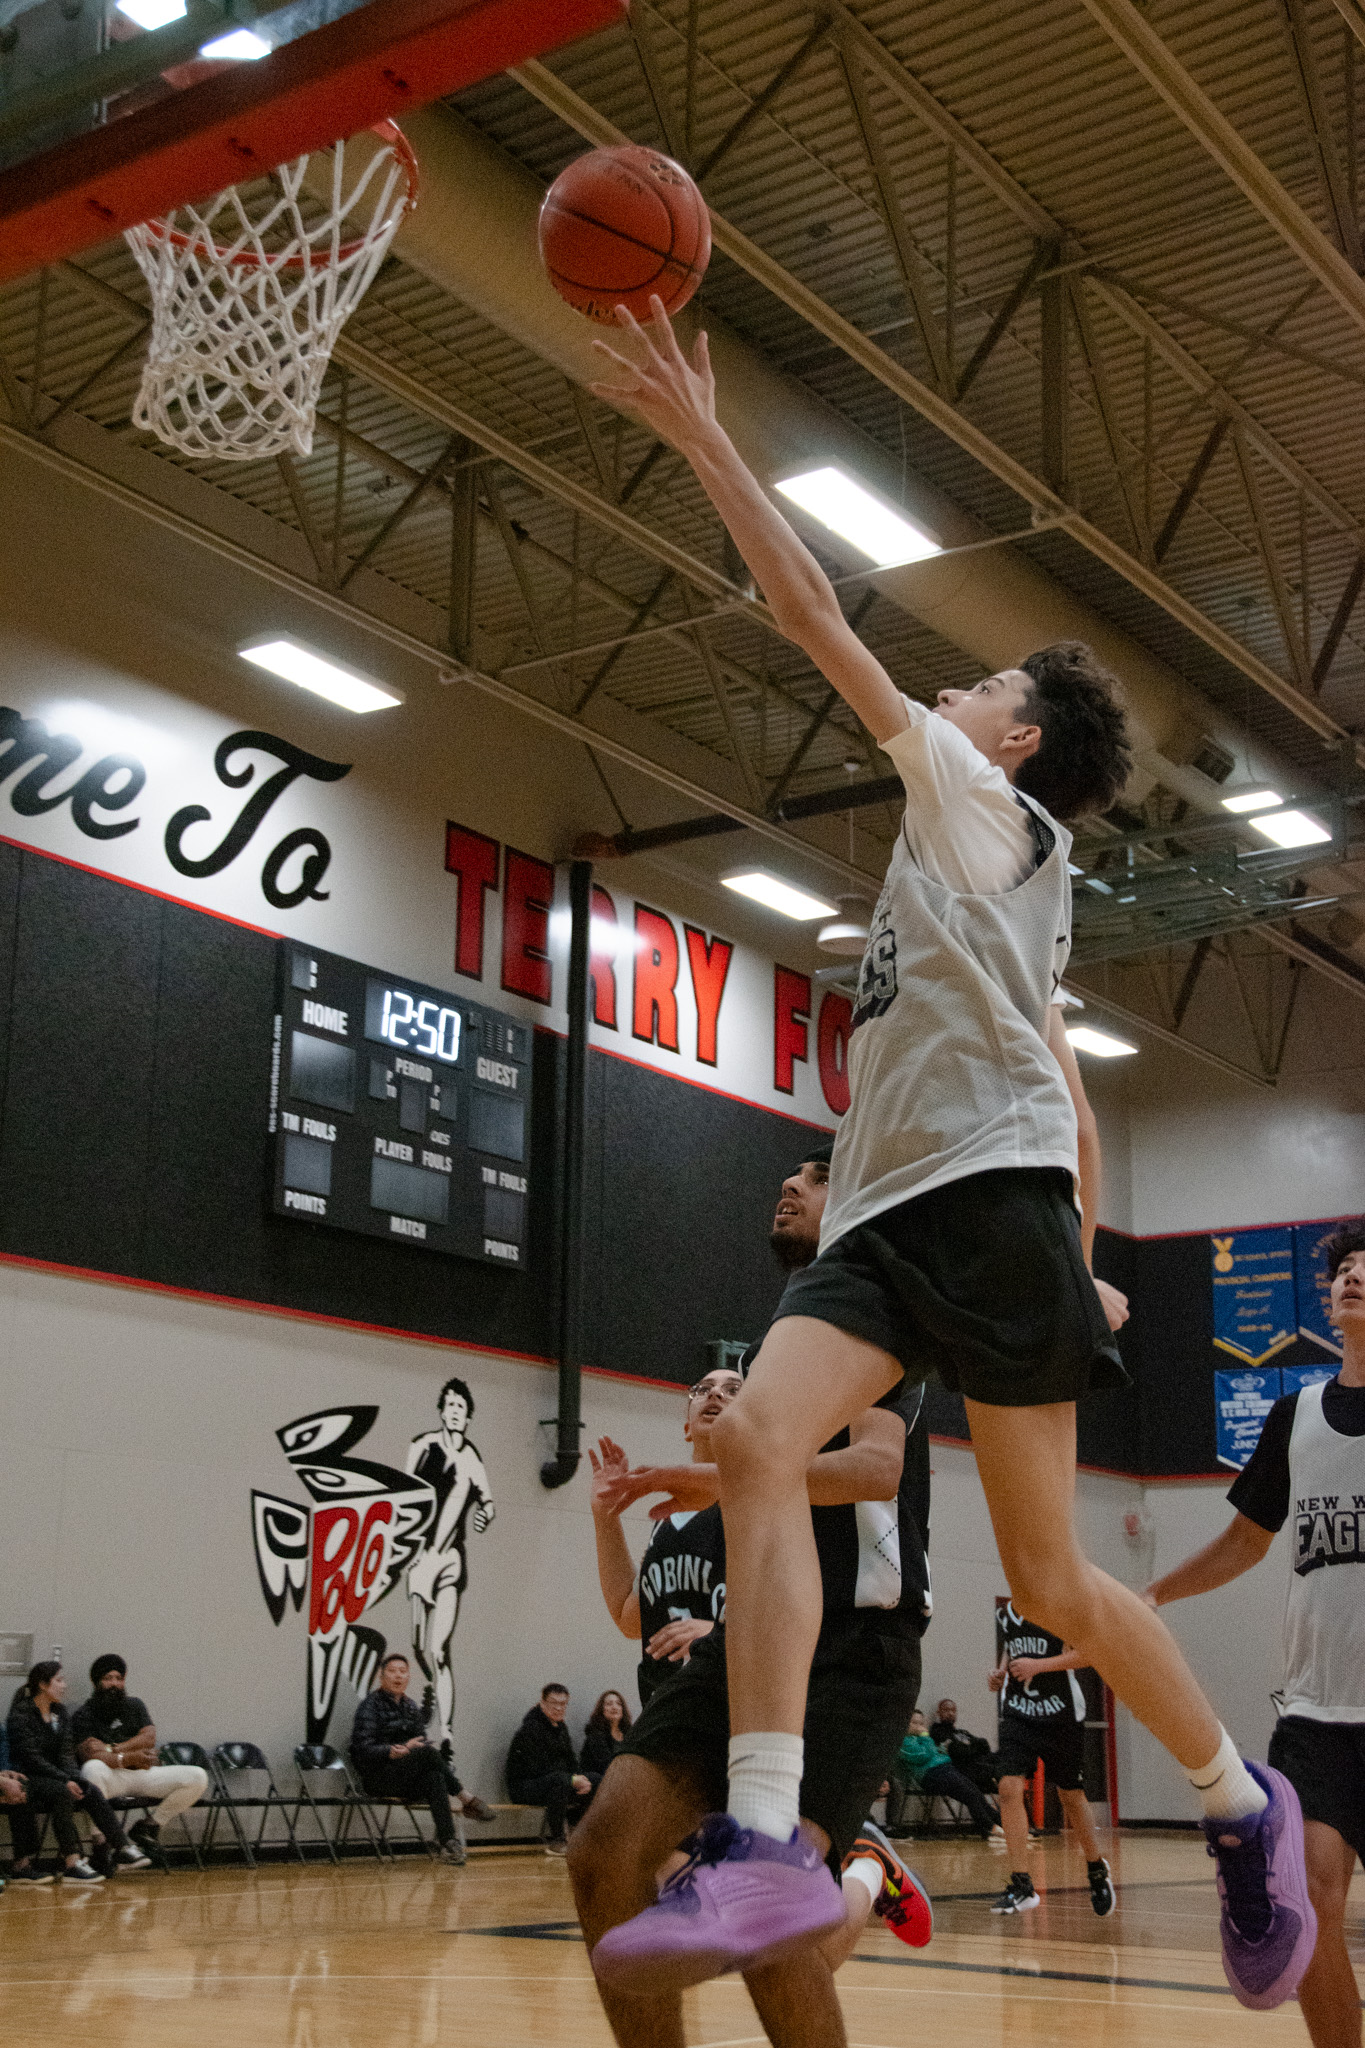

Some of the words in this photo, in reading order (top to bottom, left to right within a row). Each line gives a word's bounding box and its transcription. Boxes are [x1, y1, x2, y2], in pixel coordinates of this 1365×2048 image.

[163, 729, 353, 909] To
[445, 819, 734, 1068] TERRY
[302, 999, 349, 1036] HOME
[380, 990, 462, 1062] 12:50
[395, 1056, 434, 1084] PERIOD
[475, 1055, 519, 1090] GUEST
[282, 1110, 300, 1133] TM
[302, 1117, 337, 1142] FOULS
[374, 1135, 414, 1163] PLAYER
[421, 1149, 453, 1173] FOULS
[499, 1171, 528, 1194] FOULS
[284, 1188, 327, 1216] POINTS
[390, 1215, 427, 1241] MATCH
[484, 1238, 520, 1262] POINTS
[1296, 1495, 1340, 1514] NEW
[1009, 1636, 1048, 1658] OBIND
